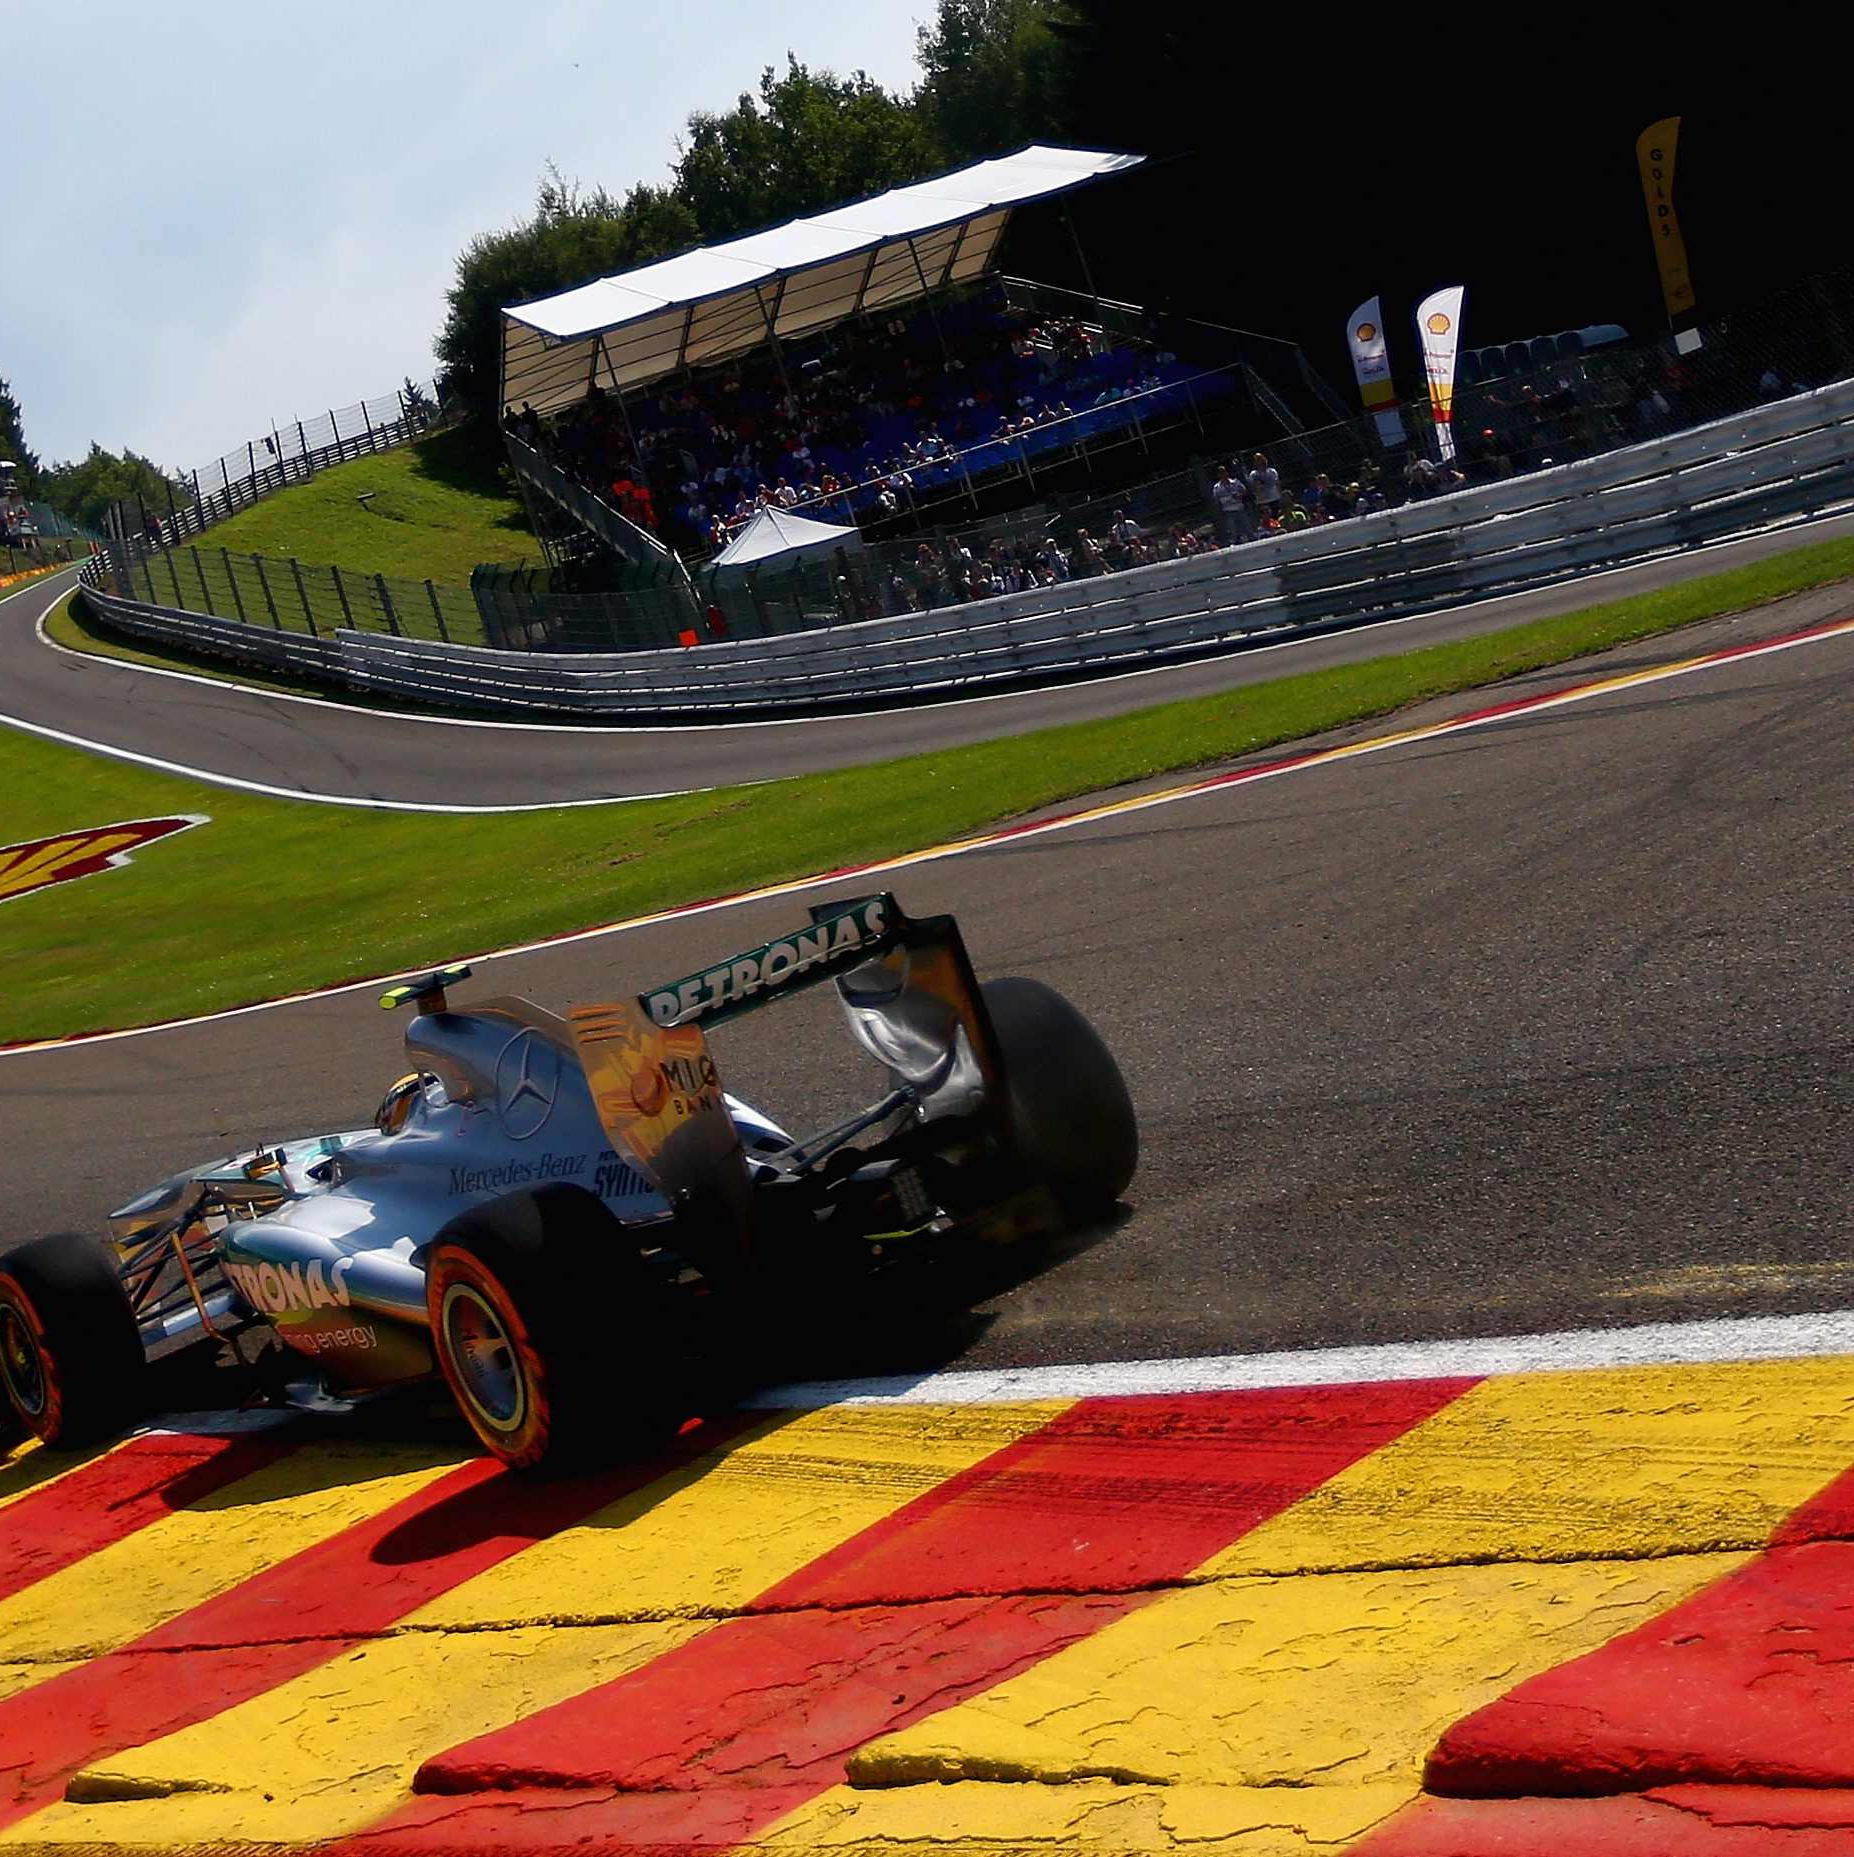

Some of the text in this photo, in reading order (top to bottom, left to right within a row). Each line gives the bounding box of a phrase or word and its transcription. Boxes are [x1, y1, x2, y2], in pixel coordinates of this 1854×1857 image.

[649, 901, 887, 1024] PETRONAS
[449, 1152, 588, 1196] Mercedes-Benz
[221, 1256, 355, 1313] TRONAS
[317, 1325, 377, 1349] energy
